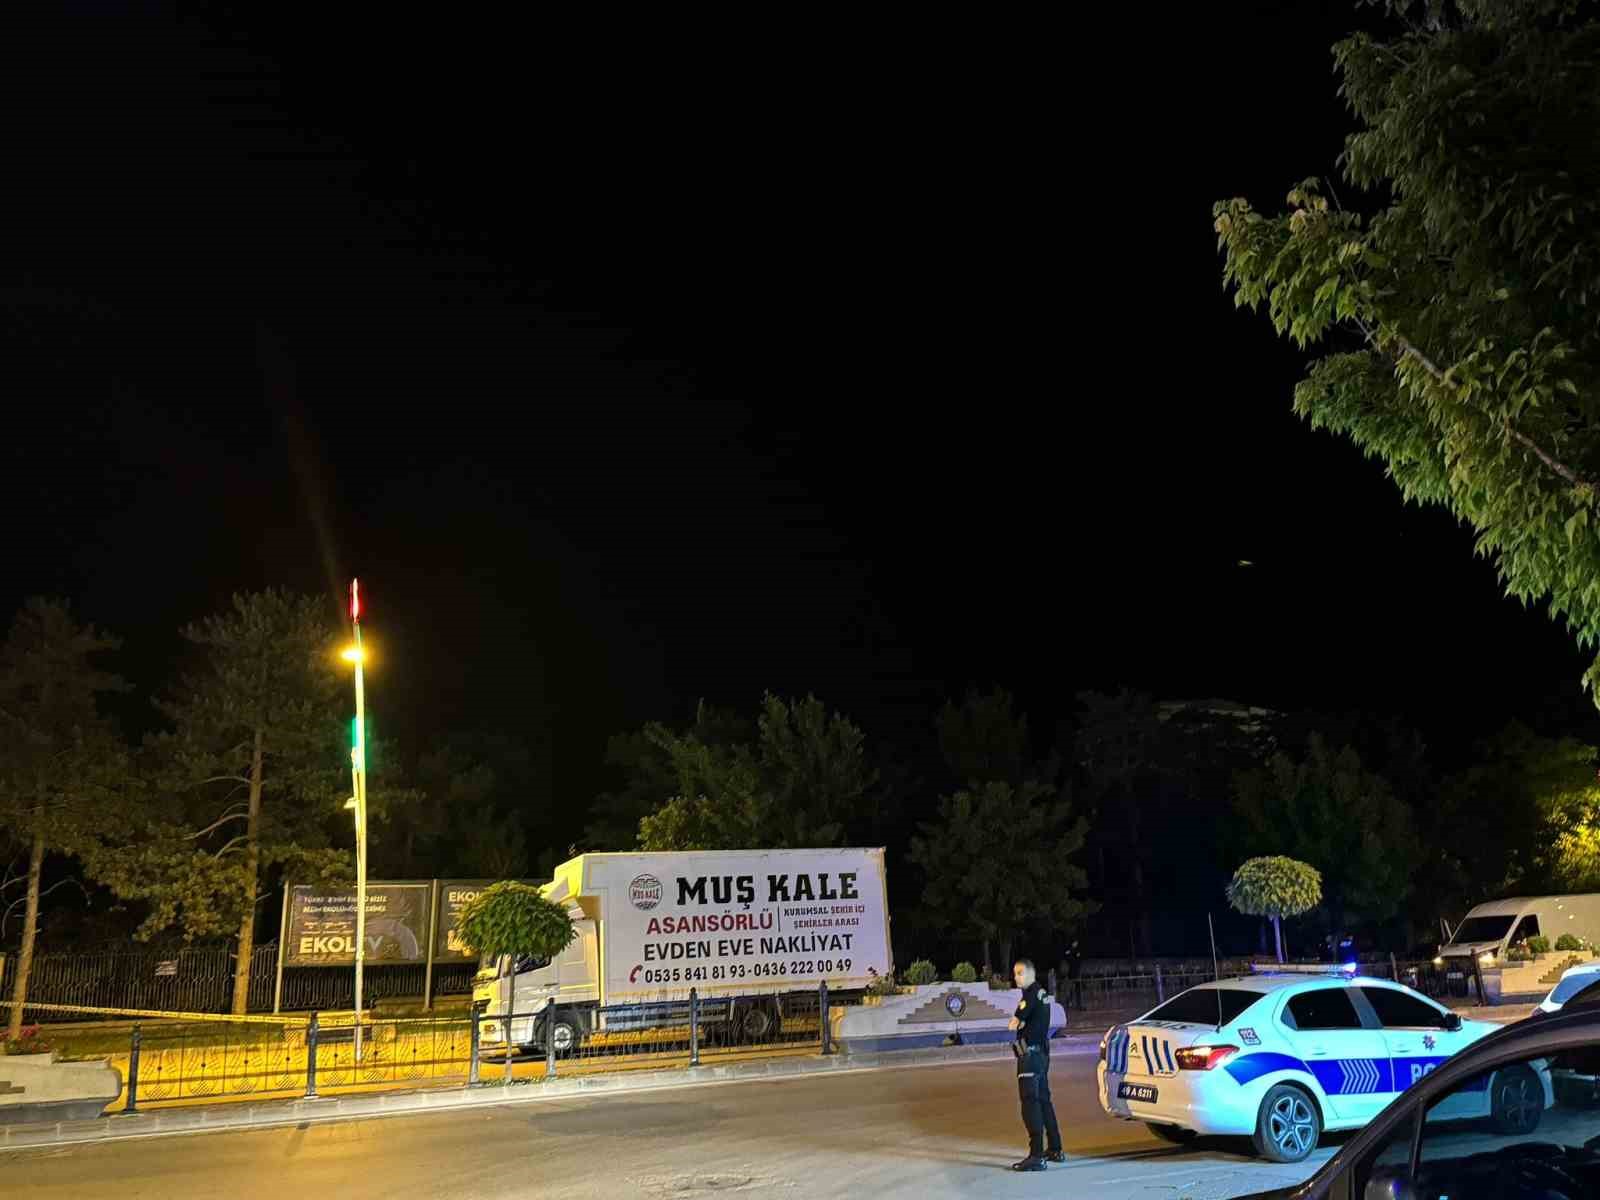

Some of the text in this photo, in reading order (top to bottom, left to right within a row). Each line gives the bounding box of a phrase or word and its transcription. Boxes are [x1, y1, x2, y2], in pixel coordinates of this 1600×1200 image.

[676, 872, 859, 910] MUŞ KALE
[646, 908, 773, 935] ASANSÖRLÜ
[783, 906, 829, 917] KURUMSAL
[793, 917, 860, 929] ŞEHİRLER ARASI
[299, 936, 356, 954] EKOL
[644, 931, 854, 962] EVDEN EVE NAKLİYAT
[645, 966, 680, 984] 0535
[684, 965, 707, 981] 841
[711, 964, 726, 979] 81
[790, 959, 813, 974] 222
[817, 958, 833, 973] 00
[836, 957, 852, 972] 49
[1131, 1087, 1137, 1097] A
